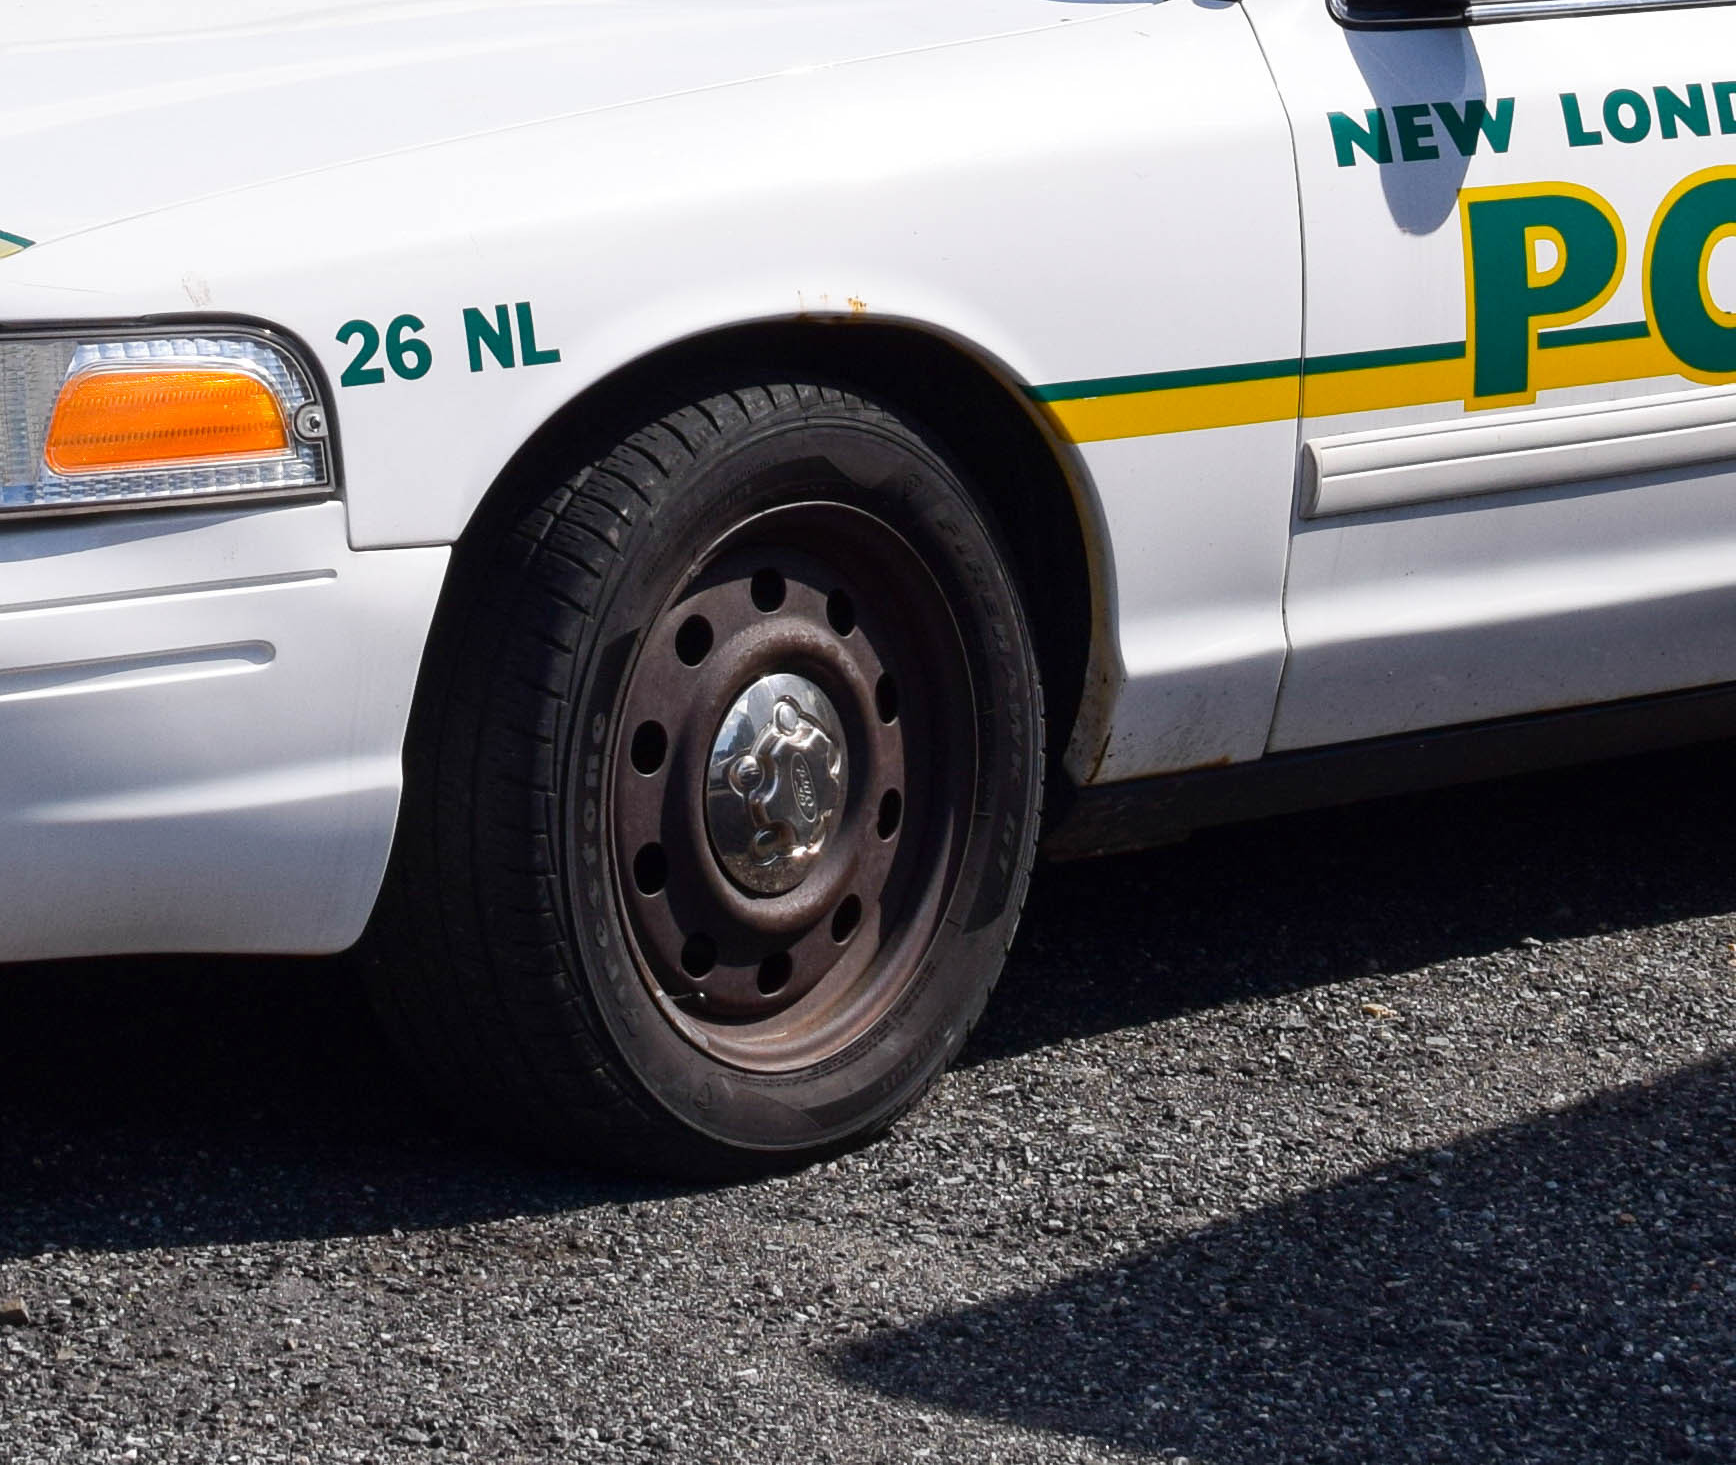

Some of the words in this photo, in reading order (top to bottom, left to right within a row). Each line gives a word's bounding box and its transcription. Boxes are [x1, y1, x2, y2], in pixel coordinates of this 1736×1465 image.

[1327, 96, 1515, 168] NEW
[335, 313, 433, 388] 26
[462, 301, 561, 373] NL
